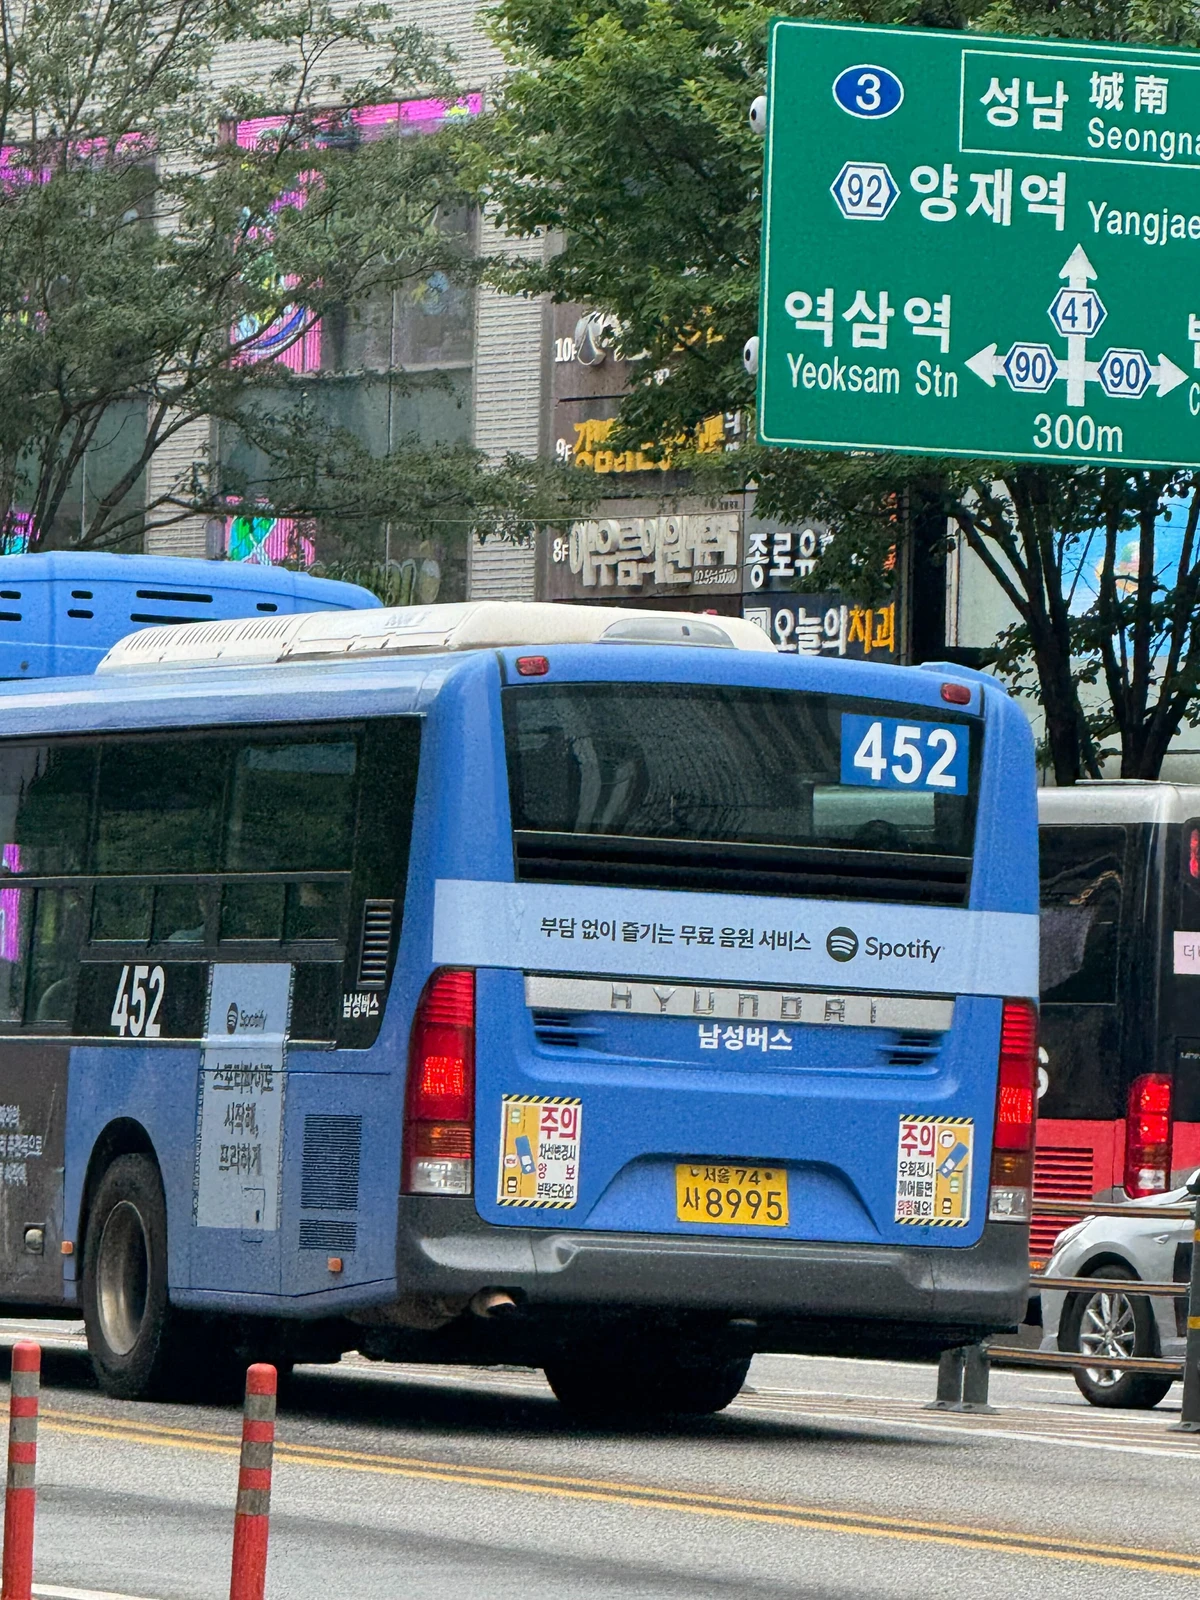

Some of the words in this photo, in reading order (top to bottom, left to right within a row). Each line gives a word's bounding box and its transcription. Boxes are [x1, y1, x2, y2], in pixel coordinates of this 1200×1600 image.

[856, 73, 882, 110] 3
[979, 77, 1070, 132] 성남
[847, 173, 882, 209] 92
[909, 163, 1066, 231] 양재역
[785, 288, 950, 354] 역삼역
[1061, 297, 1094, 329] 41
[787, 352, 900, 394] Yeoksam
[916, 360, 958, 399] Stn
[1015, 355, 1046, 382] 90
[1110, 360, 1140, 388] 90
[1033, 413, 1123, 453] 300m
[553, 537, 568, 562] 8F
[853, 722, 958, 789] 452
[540, 917, 576, 939] 부담
[582, 918, 616, 942] 없이
[622, 920, 674, 945] 즐기는
[679, 924, 715, 946] 무료
[720, 926, 755, 949] 음원
[759, 928, 812, 952] 서비스
[865, 936, 942, 964] Spotify
[110, 965, 165, 1037] 452
[343, 993, 380, 1019] 남성버스
[698, 1023, 793, 1053] 남성버스
[540, 1106, 578, 1141] 주의
[901, 1124, 935, 1158] 주의
[704, 1167, 731, 1184] 서울
[735, 1169, 761, 1186] 74
